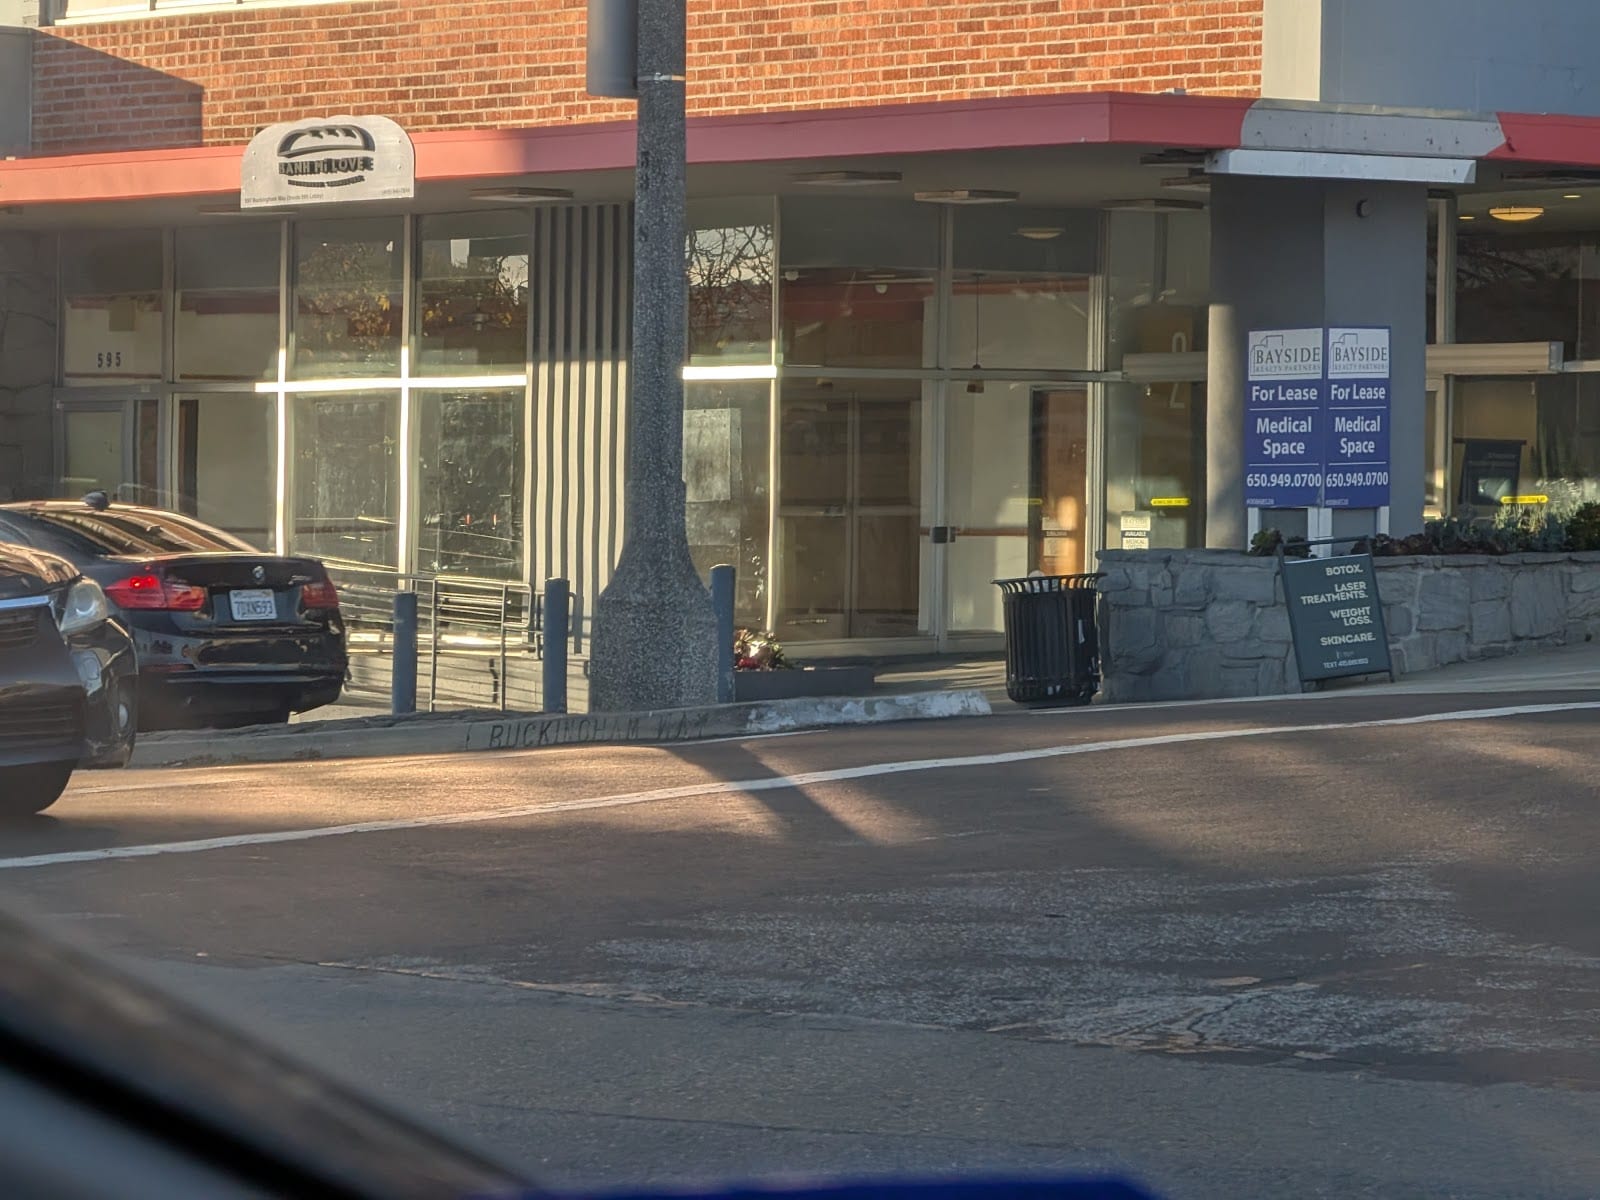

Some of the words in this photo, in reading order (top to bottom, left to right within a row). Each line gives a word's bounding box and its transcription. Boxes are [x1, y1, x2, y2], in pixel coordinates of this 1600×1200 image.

[279, 161, 310, 176] BANH
[331, 156, 370, 173] LOVE
[97, 351, 121, 368] 595
[1256, 347, 1320, 364] BAYSIDE
[1335, 347, 1388, 362] BAYSIDE
[1252, 386, 1275, 402] For
[1278, 385, 1318, 401] Lease
[1331, 384, 1350, 400] For
[1353, 384, 1385, 400] Lease
[1256, 416, 1312, 434] Medical
[1335, 416, 1380, 432] Medical
[1263, 438, 1305, 458] Space
[1340, 438, 1375, 457] Space
[1247, 473, 1321, 487] 650.949.0700
[1326, 472, 1388, 486] 650.949.0700
[1325, 564, 1363, 576] BOTOX.
[1335, 581, 1366, 592] LASER
[1300, 590, 1368, 605] TREATMENTS.
[1330, 606, 1371, 619] WEIGHT
[1344, 616, 1373, 626] LOSS.
[1320, 632, 1376, 646] SKINCARE.
